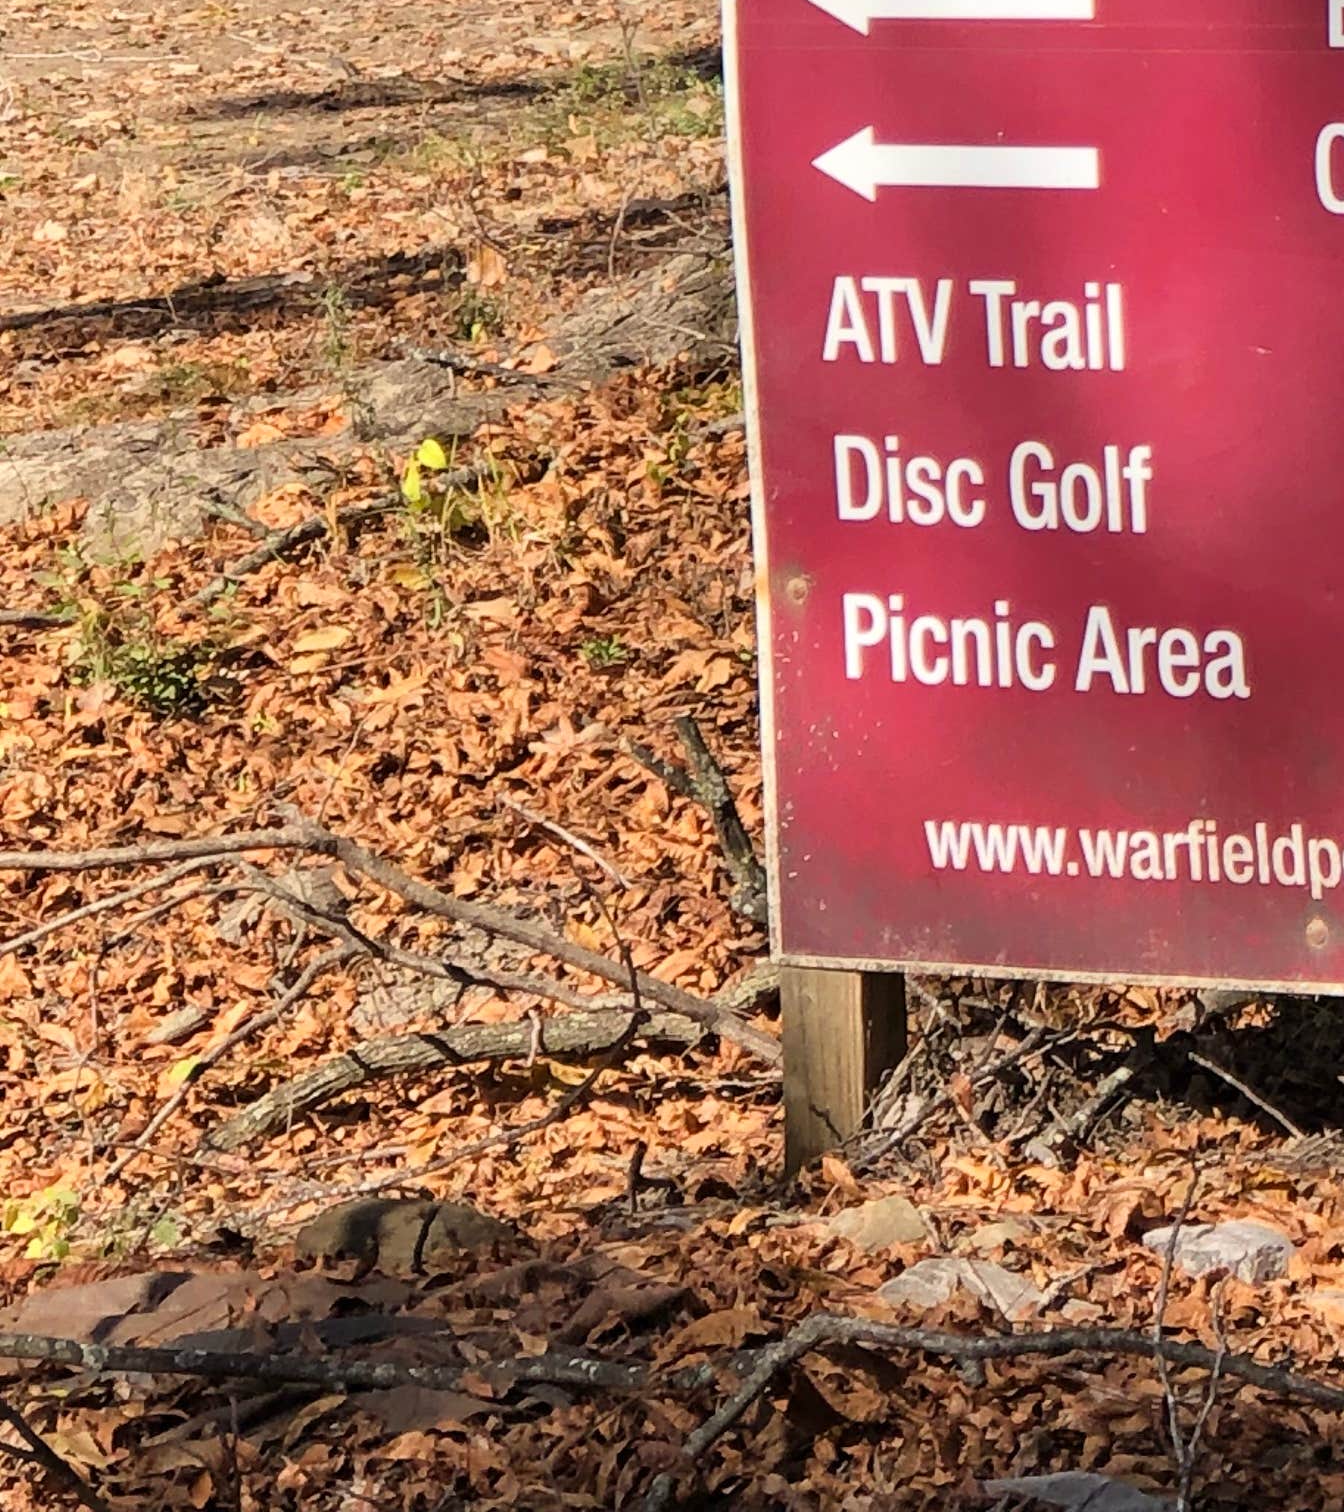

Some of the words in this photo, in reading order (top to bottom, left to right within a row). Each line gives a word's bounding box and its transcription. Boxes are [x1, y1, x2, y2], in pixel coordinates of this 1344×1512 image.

[822, 275, 953, 365] ATV
[969, 280, 1126, 371] Trail
[834, 434, 986, 528] Disc
[1009, 440, 1153, 533] Golf
[843, 592, 1057, 691] Picnic
[1075, 606, 1251, 699] Area
